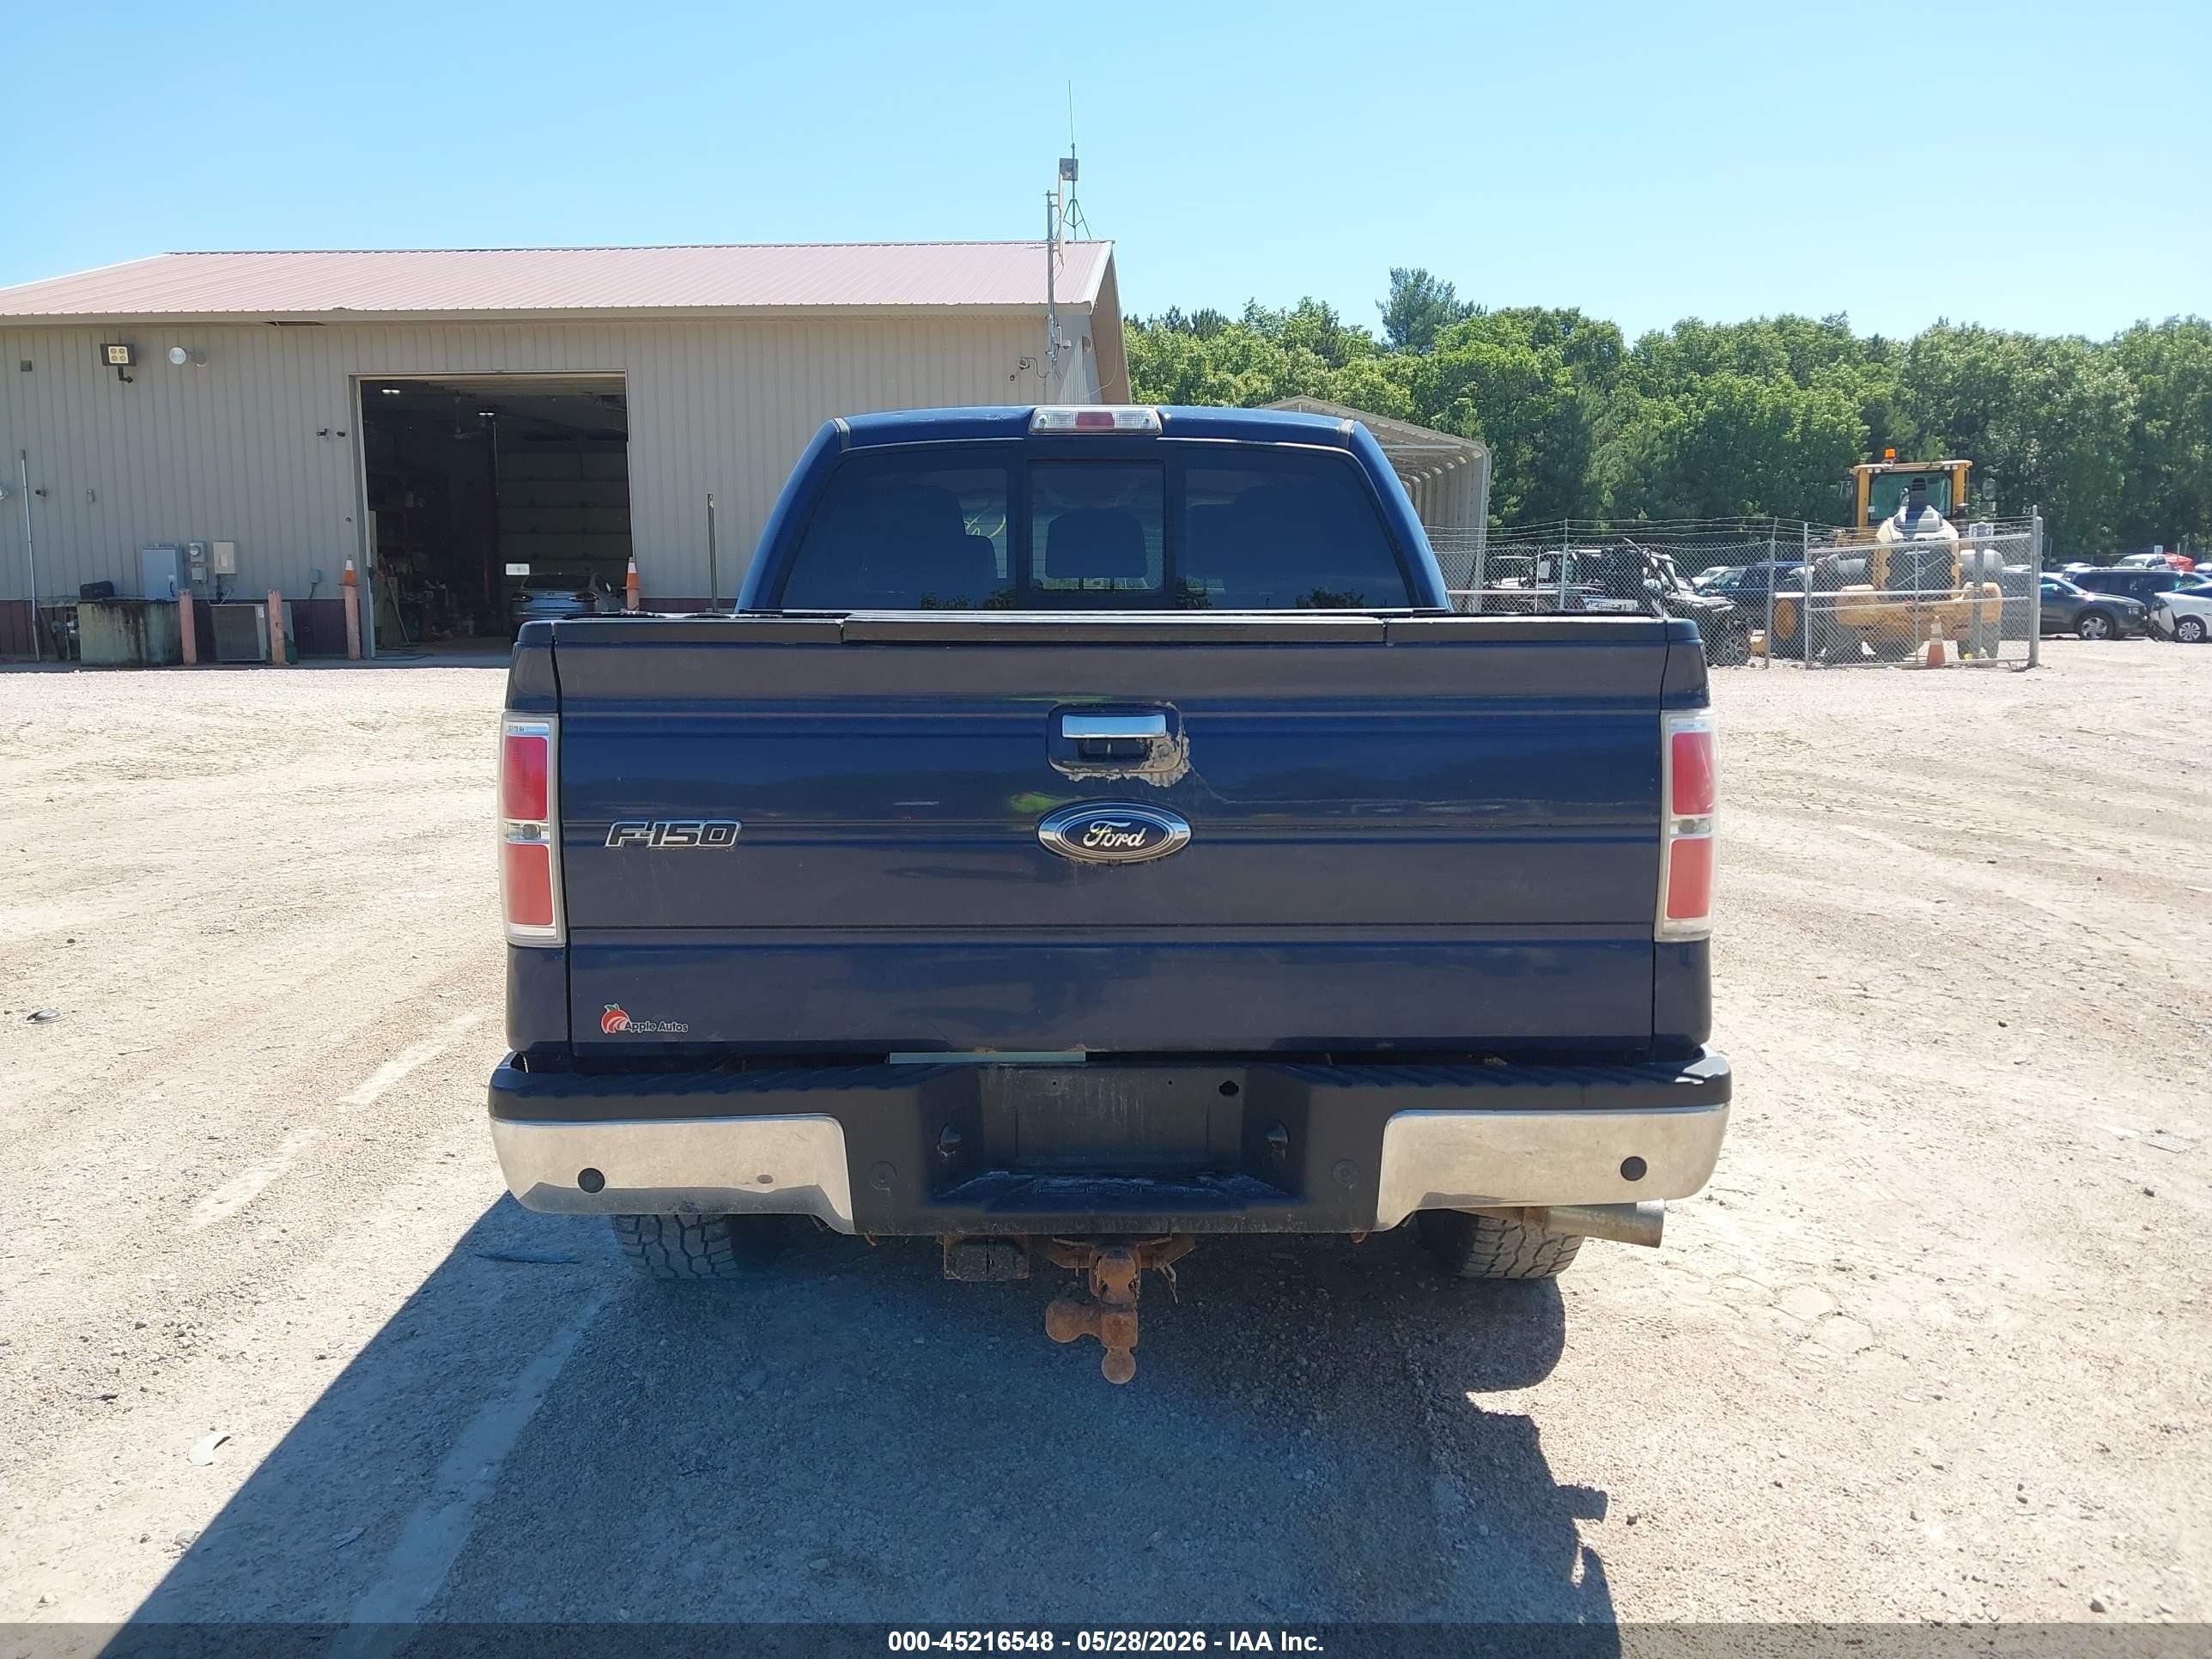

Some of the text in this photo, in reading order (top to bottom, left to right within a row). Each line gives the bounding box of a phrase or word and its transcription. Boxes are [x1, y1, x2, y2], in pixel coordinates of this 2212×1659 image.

[605, 819, 744, 848] F-150
[1083, 820, 1147, 848] Ford
[625, 1021, 688, 1033] Apple Autos
